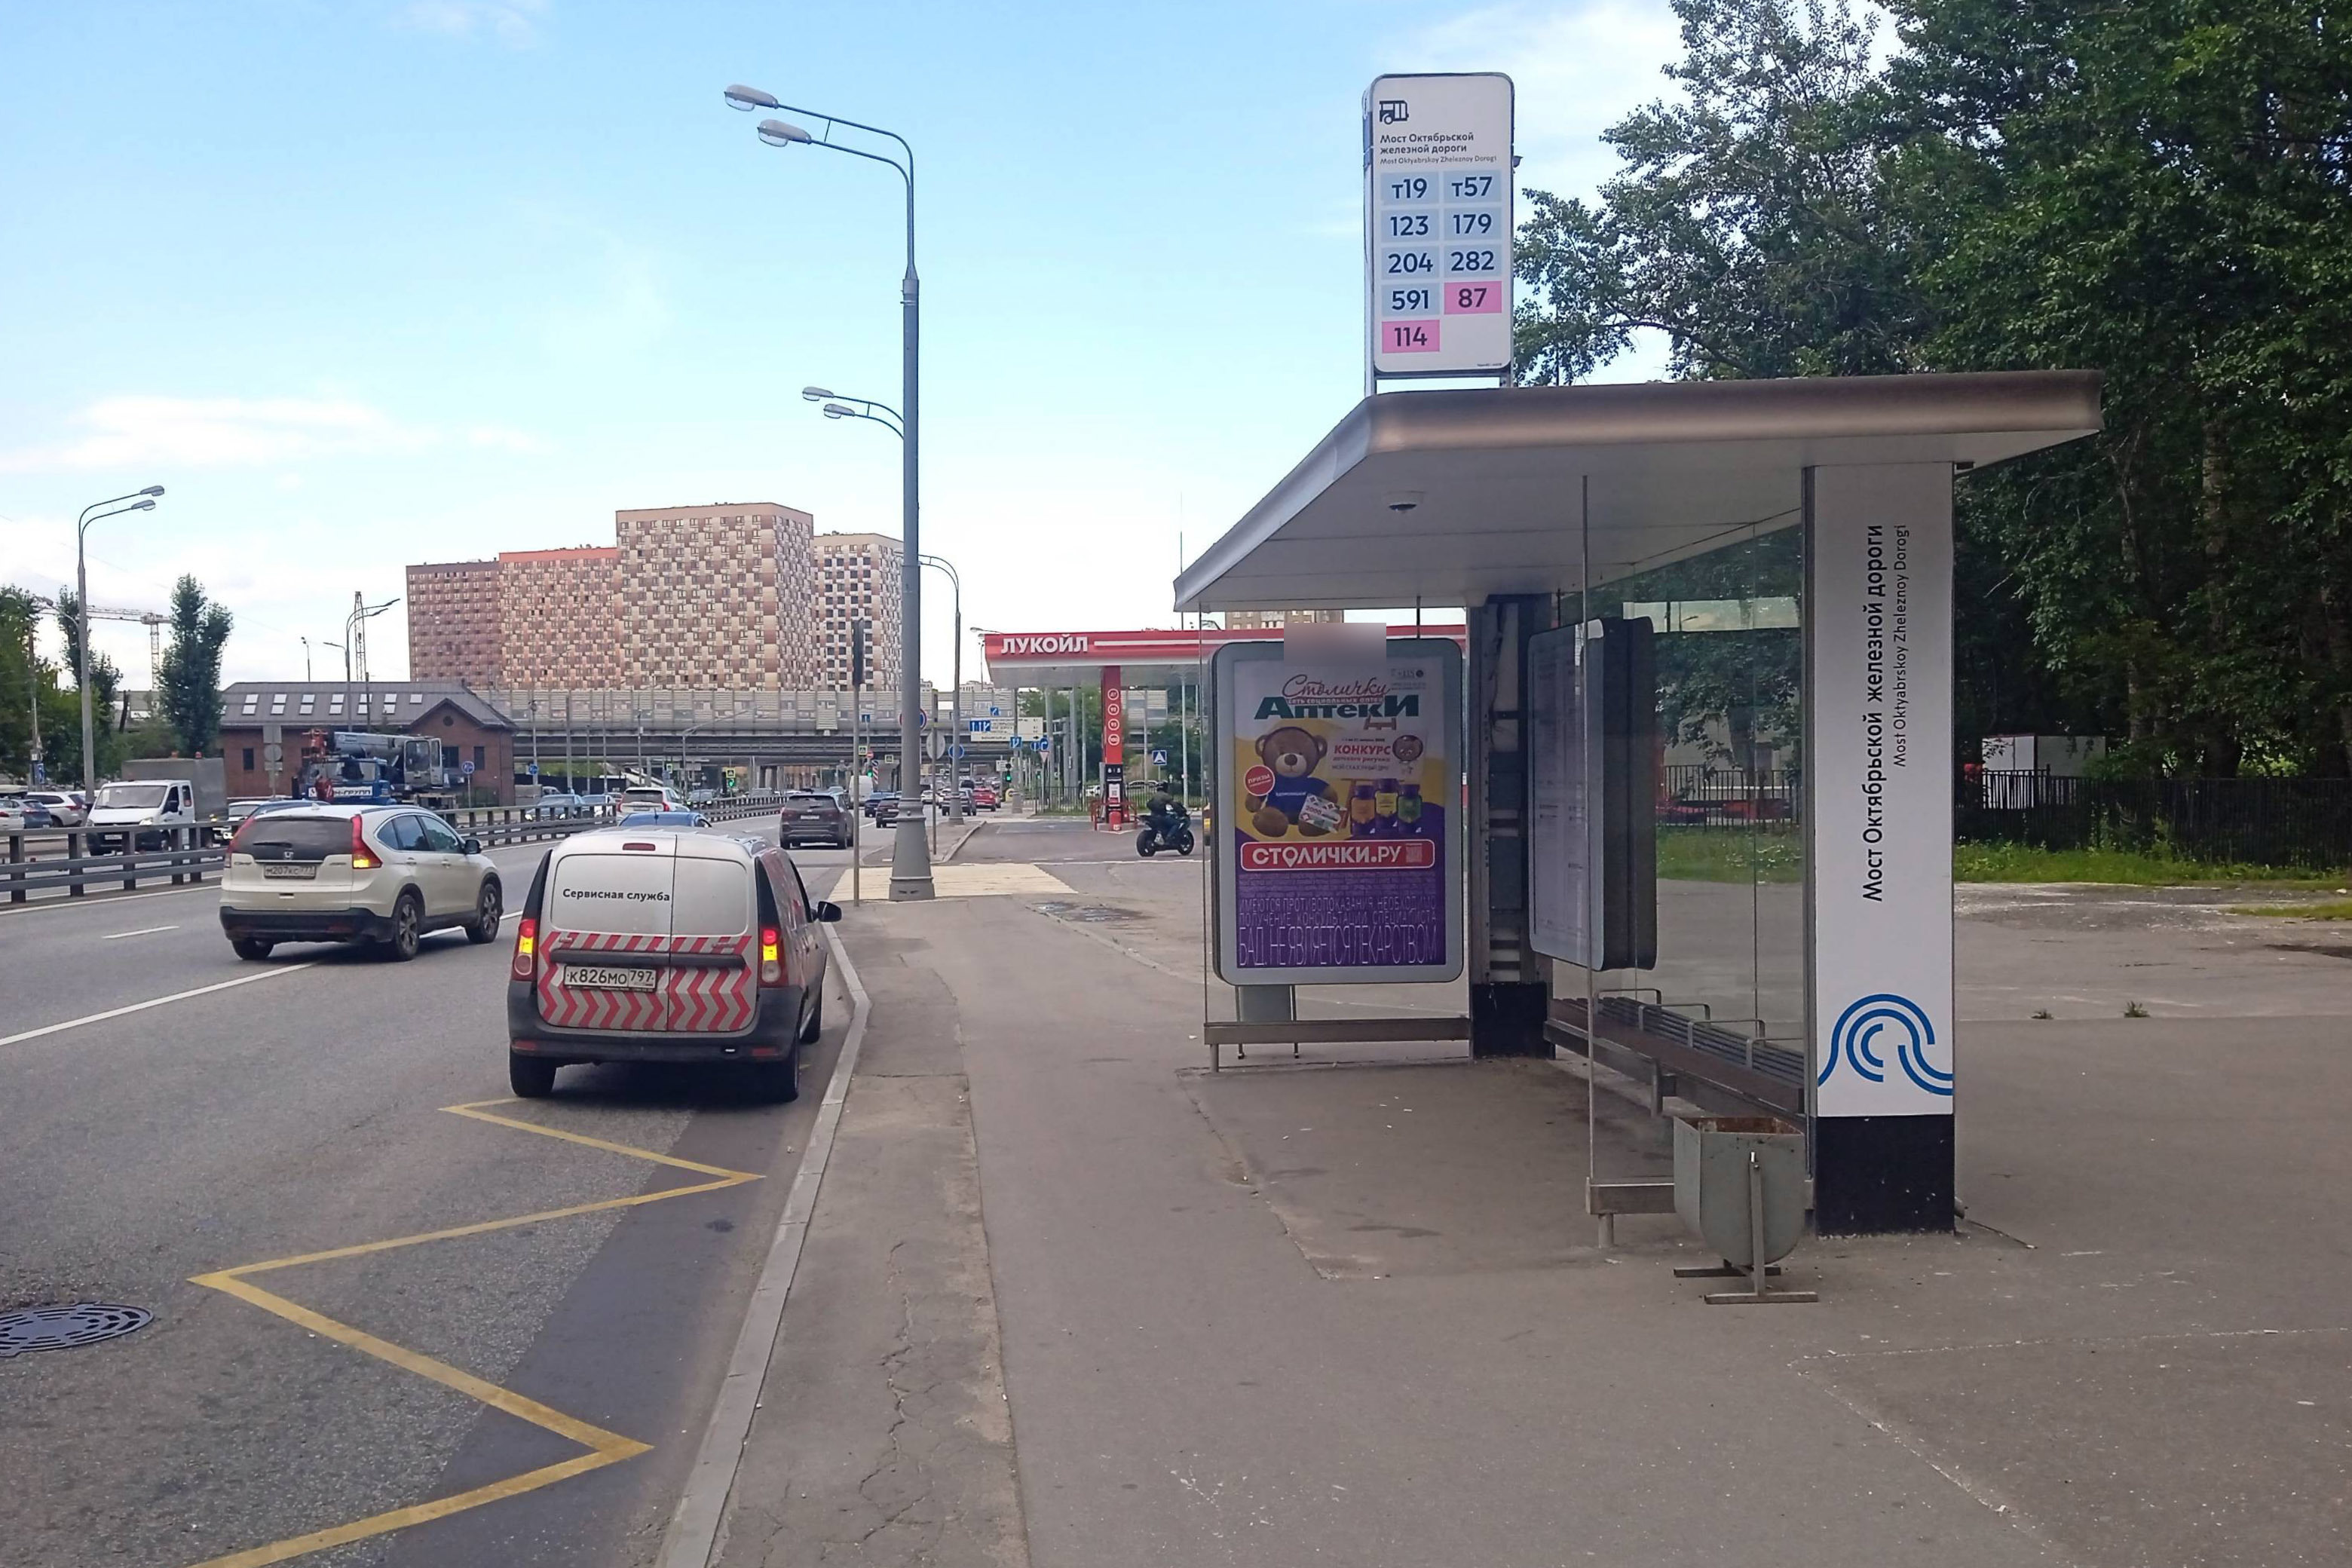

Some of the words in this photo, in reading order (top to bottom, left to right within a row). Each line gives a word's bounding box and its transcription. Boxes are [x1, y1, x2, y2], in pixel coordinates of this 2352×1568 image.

[1380, 135, 1407, 143] Мост
[1409, 133, 1474, 142] Октябрьской
[1380, 144, 1429, 155] железной
[1432, 144, 1467, 155] дороги
[1398, 156, 1439, 164] Oktyabrskoy
[1441, 155, 1473, 164] Zheleznoy
[1390, 216, 1429, 236] 123
[1453, 213, 1492, 234] 179
[1388, 253, 1433, 274] 204
[1450, 250, 1494, 271] 282
[1392, 289, 1429, 311] 591
[1458, 288, 1487, 308] 87
[1394, 326, 1428, 347] 114
[1892, 524, 1909, 570] Dorogi
[1866, 524, 1887, 596] дороги
[1892, 574, 1909, 642] Zheleznoy
[1001, 634, 1088, 654] ЛУКОЙЛ
[1862, 602, 1883, 702] железной
[1282, 674, 1390, 698] Столички
[1892, 645, 1909, 729] Oktyabrskoy
[1334, 745, 1391, 755] КОНКУРС
[1892, 732, 1906, 767] Most
[1248, 773, 1270, 784] ПРИЗЫ
[1862, 711, 1887, 843] Октябрьской
[1252, 845, 1401, 868] СТОЛИЧКИ.РУ
[1862, 848, 1883, 902] Мост
[563, 888, 623, 900] Сервисная
[627, 891, 670, 902] служба
[570, 969, 627, 985] К826МО
[630, 970, 653, 982] 797
